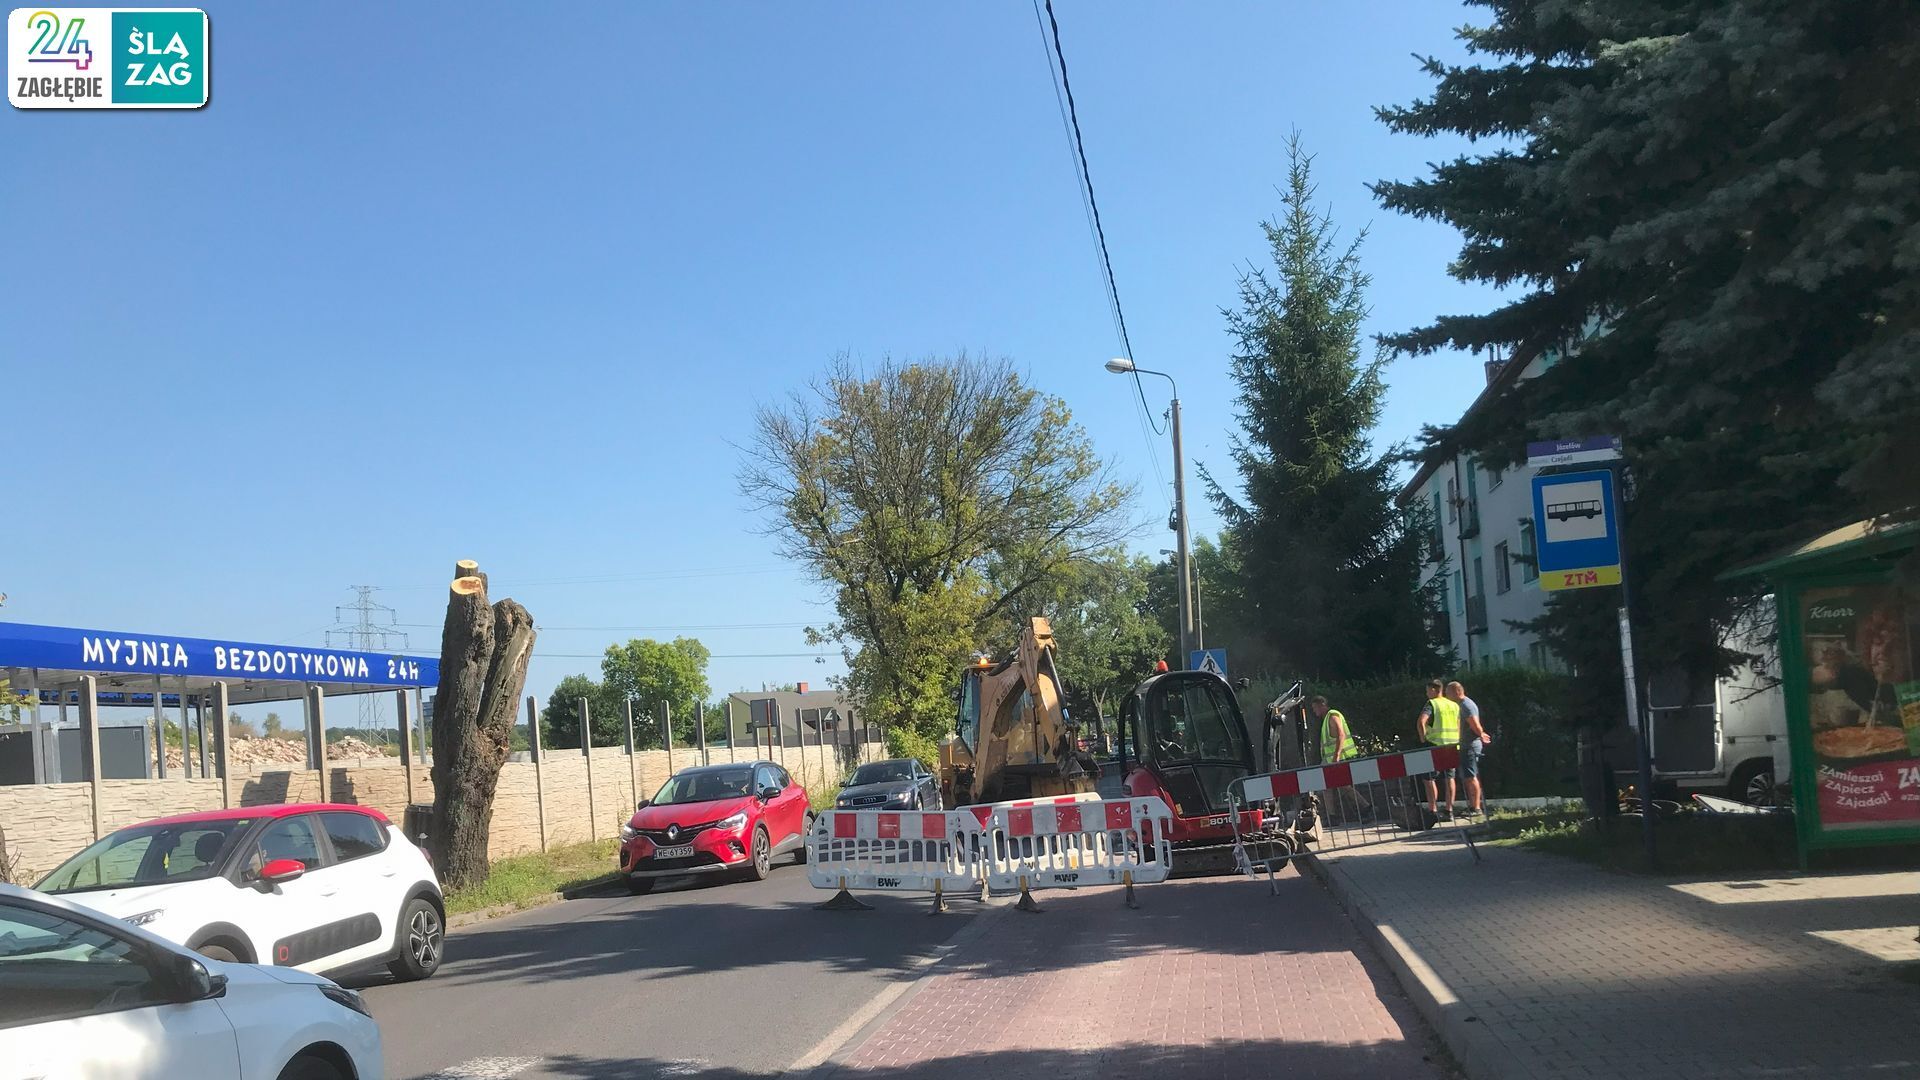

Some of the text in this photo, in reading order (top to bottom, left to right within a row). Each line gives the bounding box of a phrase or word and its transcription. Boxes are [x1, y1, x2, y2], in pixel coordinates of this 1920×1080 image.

[1564, 570, 1598, 586] ZTM
[1809, 605, 1856, 619] Knorr
[83, 637, 420, 680] MYJNIA BEZDOTYKOWA 24H
[1820, 764, 1884, 782] ZAmieszaj
[1825, 780, 1876, 794] ZApiecz
[657, 847, 692, 858] WE 6Y359
